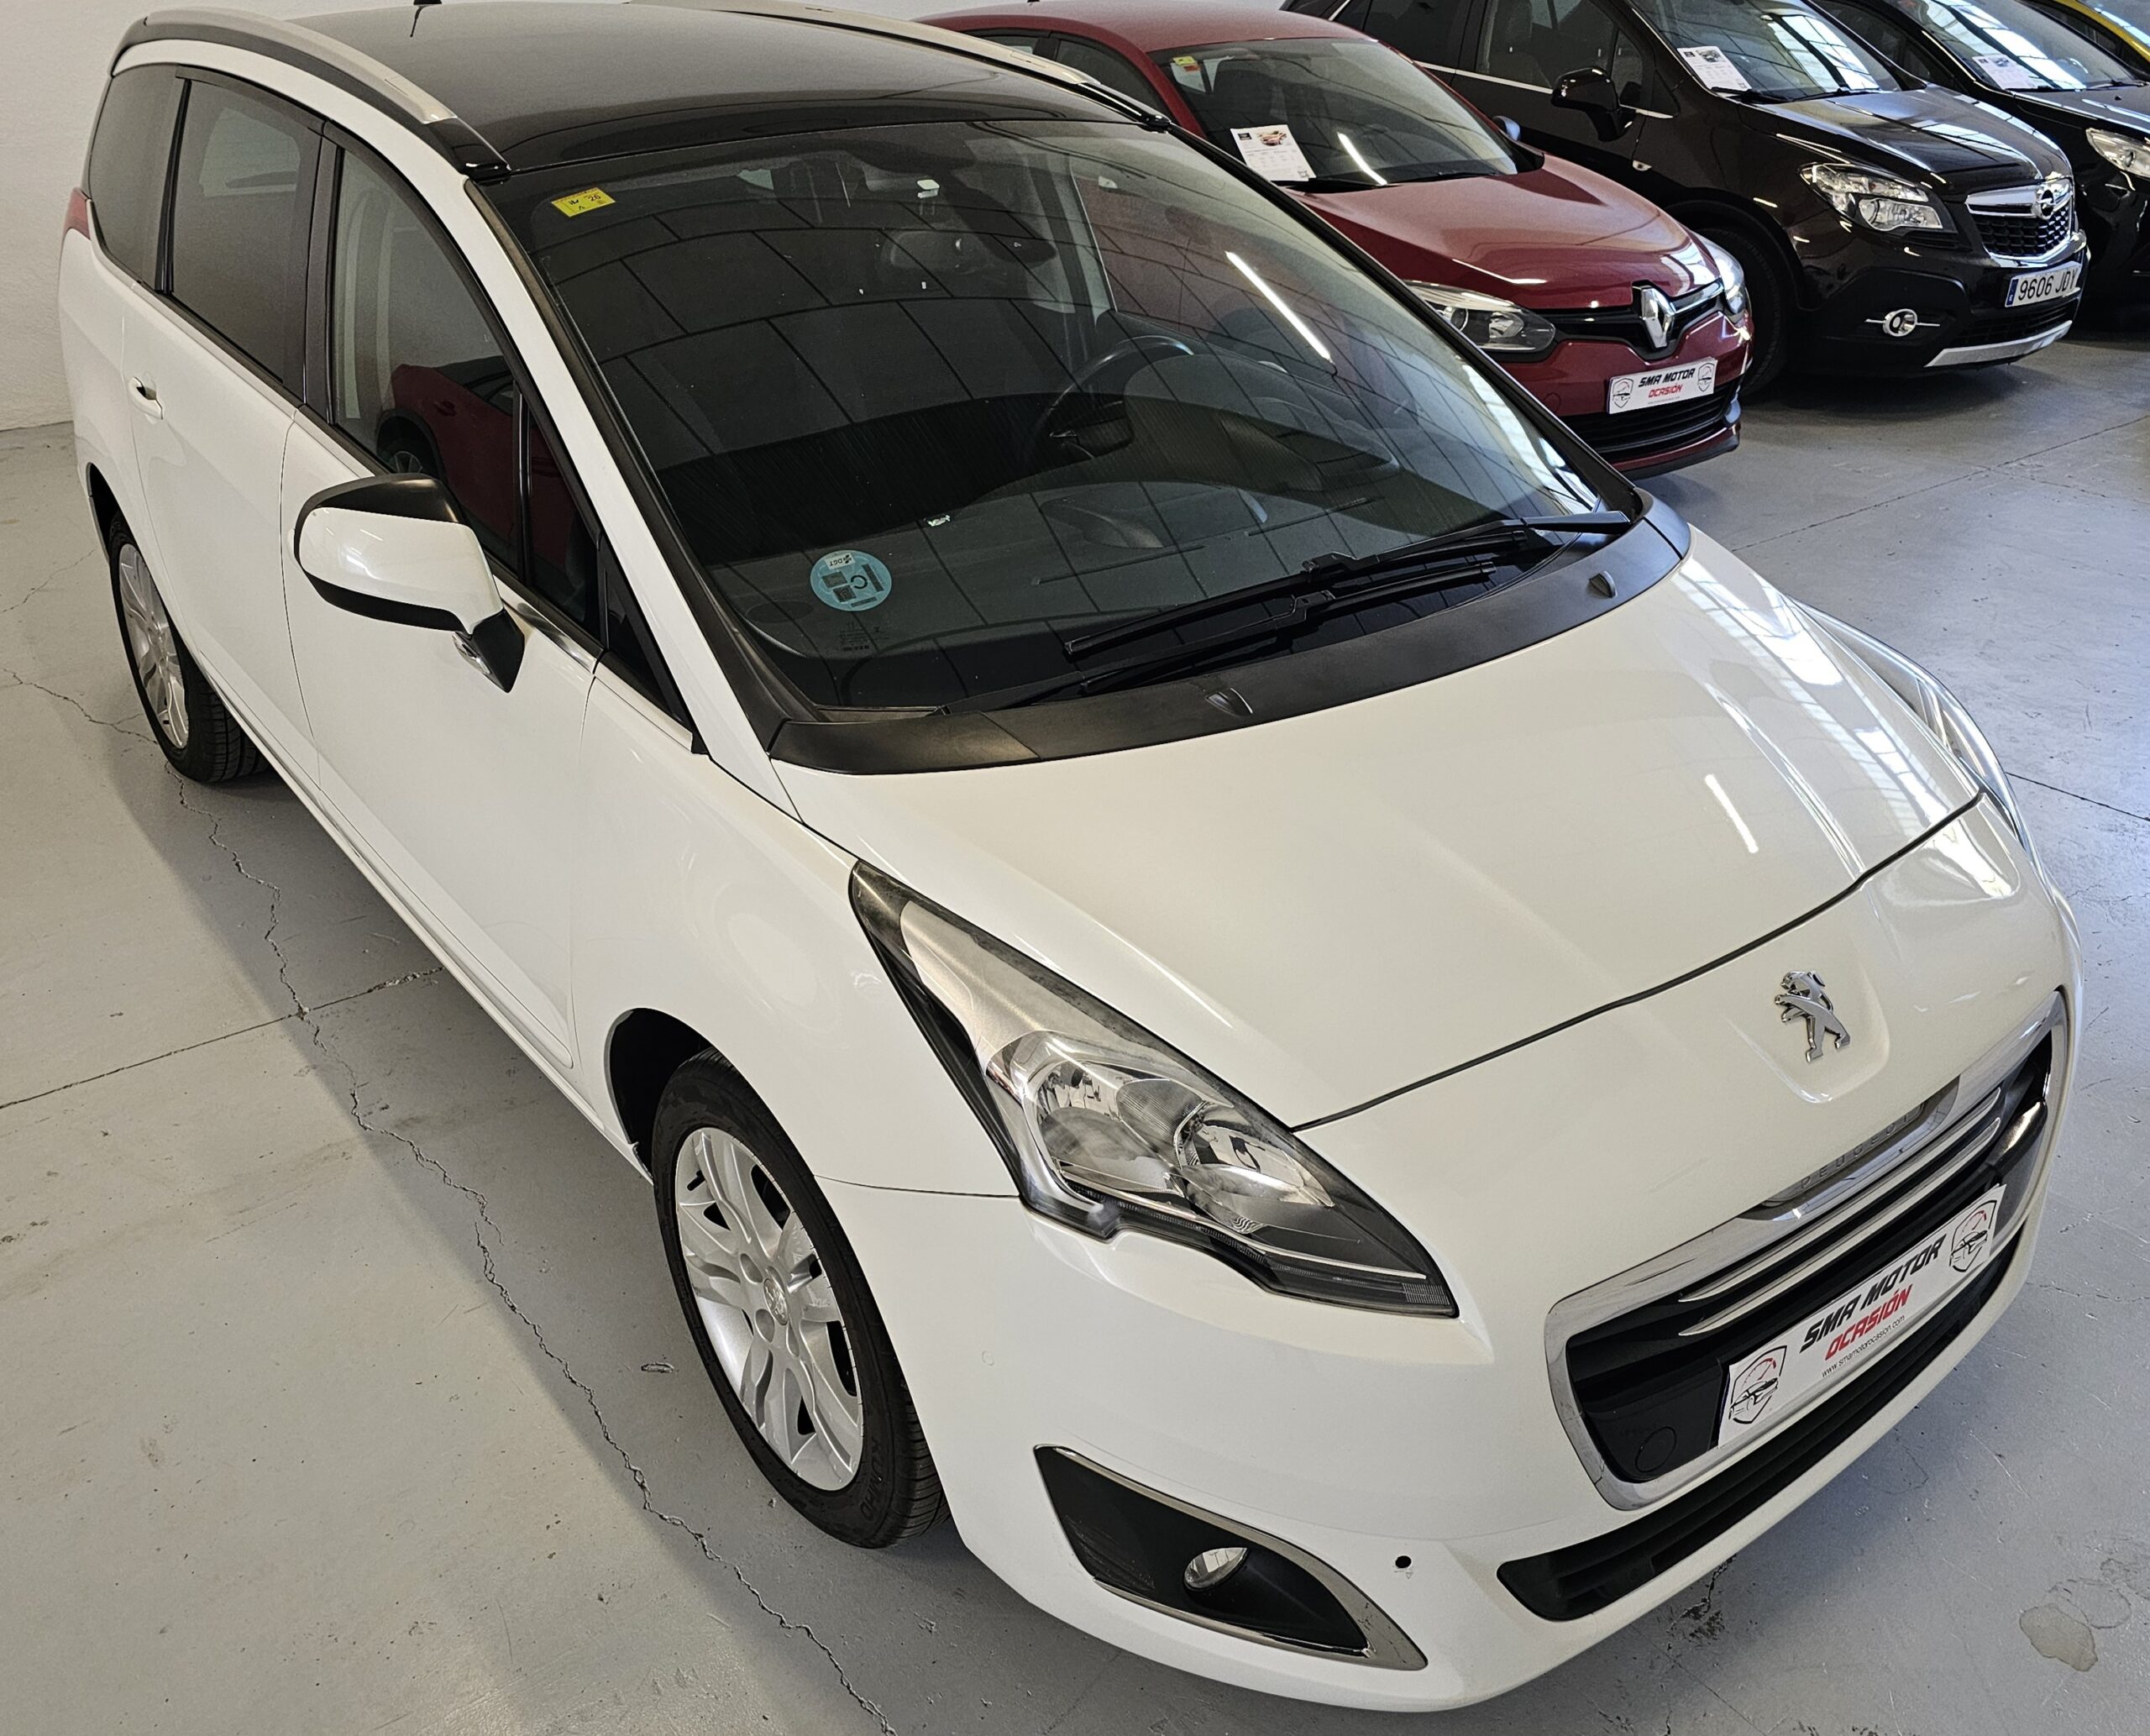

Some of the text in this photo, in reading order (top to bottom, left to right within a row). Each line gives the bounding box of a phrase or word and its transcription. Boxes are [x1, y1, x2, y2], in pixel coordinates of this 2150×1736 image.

[2018, 268, 2079, 301] 9606 JDY
[1638, 368, 1696, 387] SMA MOTOR
[1799, 1234, 1947, 1353] SMA MOTOR
[1825, 1284, 1914, 1361] OCASIÓN
